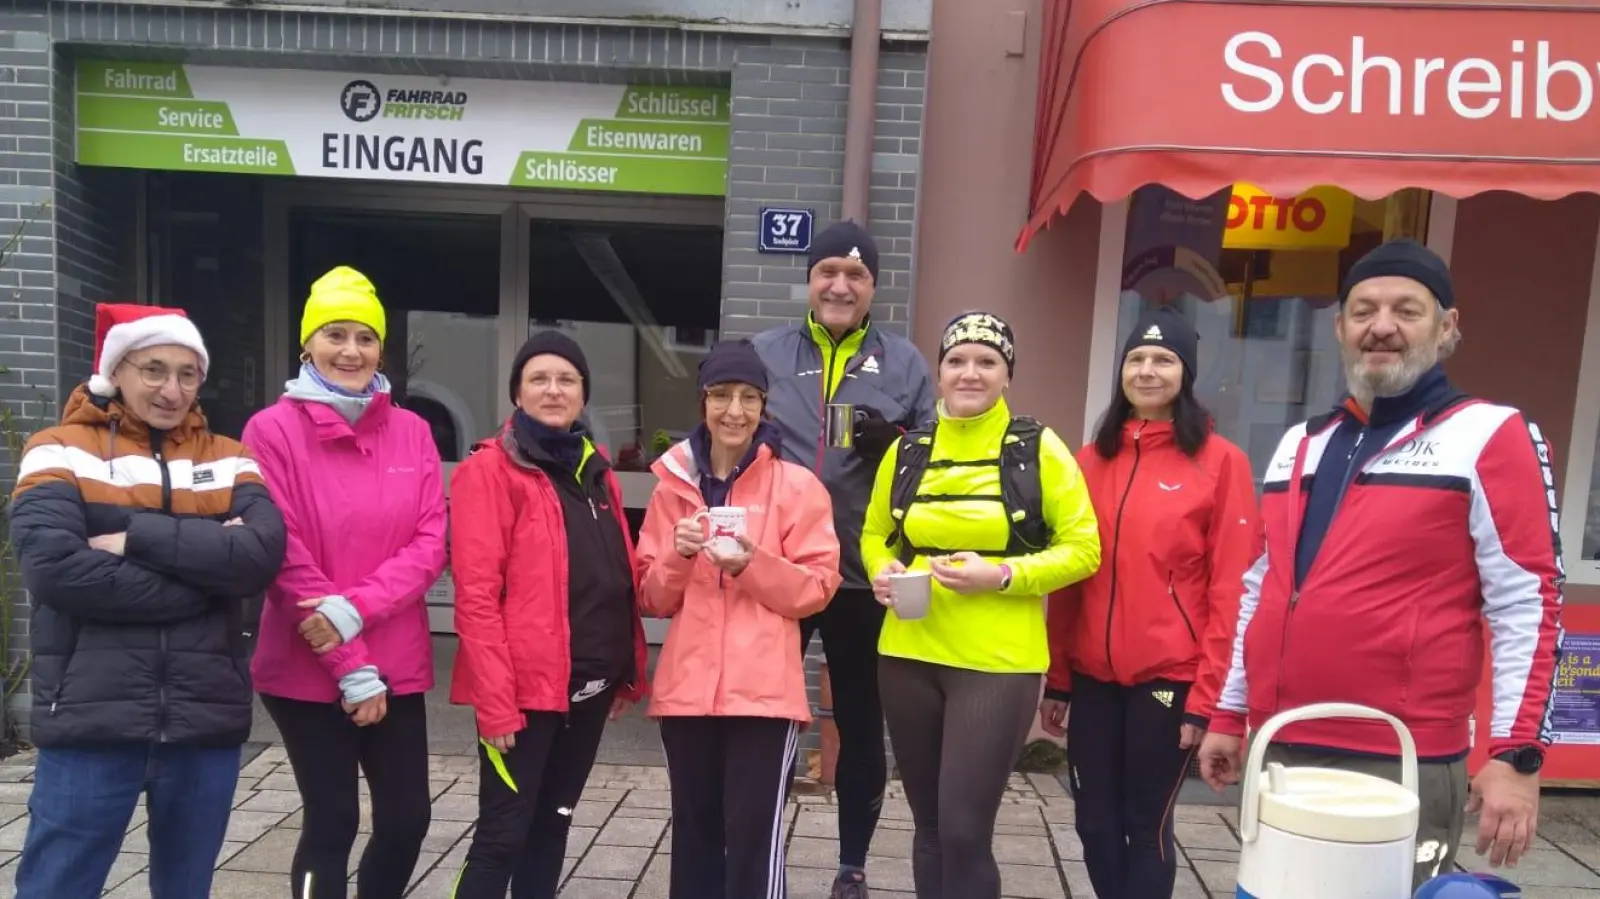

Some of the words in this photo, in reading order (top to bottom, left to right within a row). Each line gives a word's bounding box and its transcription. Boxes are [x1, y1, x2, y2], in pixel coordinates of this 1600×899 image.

[104, 67, 178, 92] Fahrrad
[1220, 31, 1600, 121] Schreib
[386, 89, 468, 105] FAHRRAD
[627, 90, 718, 118] Schlüssel
[157, 106, 224, 129] Service
[382, 103, 465, 121] FRITSCH
[586, 124, 703, 152] Eisenwaren
[182, 142, 279, 168] Ersatzteile
[321, 131, 484, 175] EINGANG
[524, 156, 619, 186] Schlösser
[771, 213, 803, 237] 37
